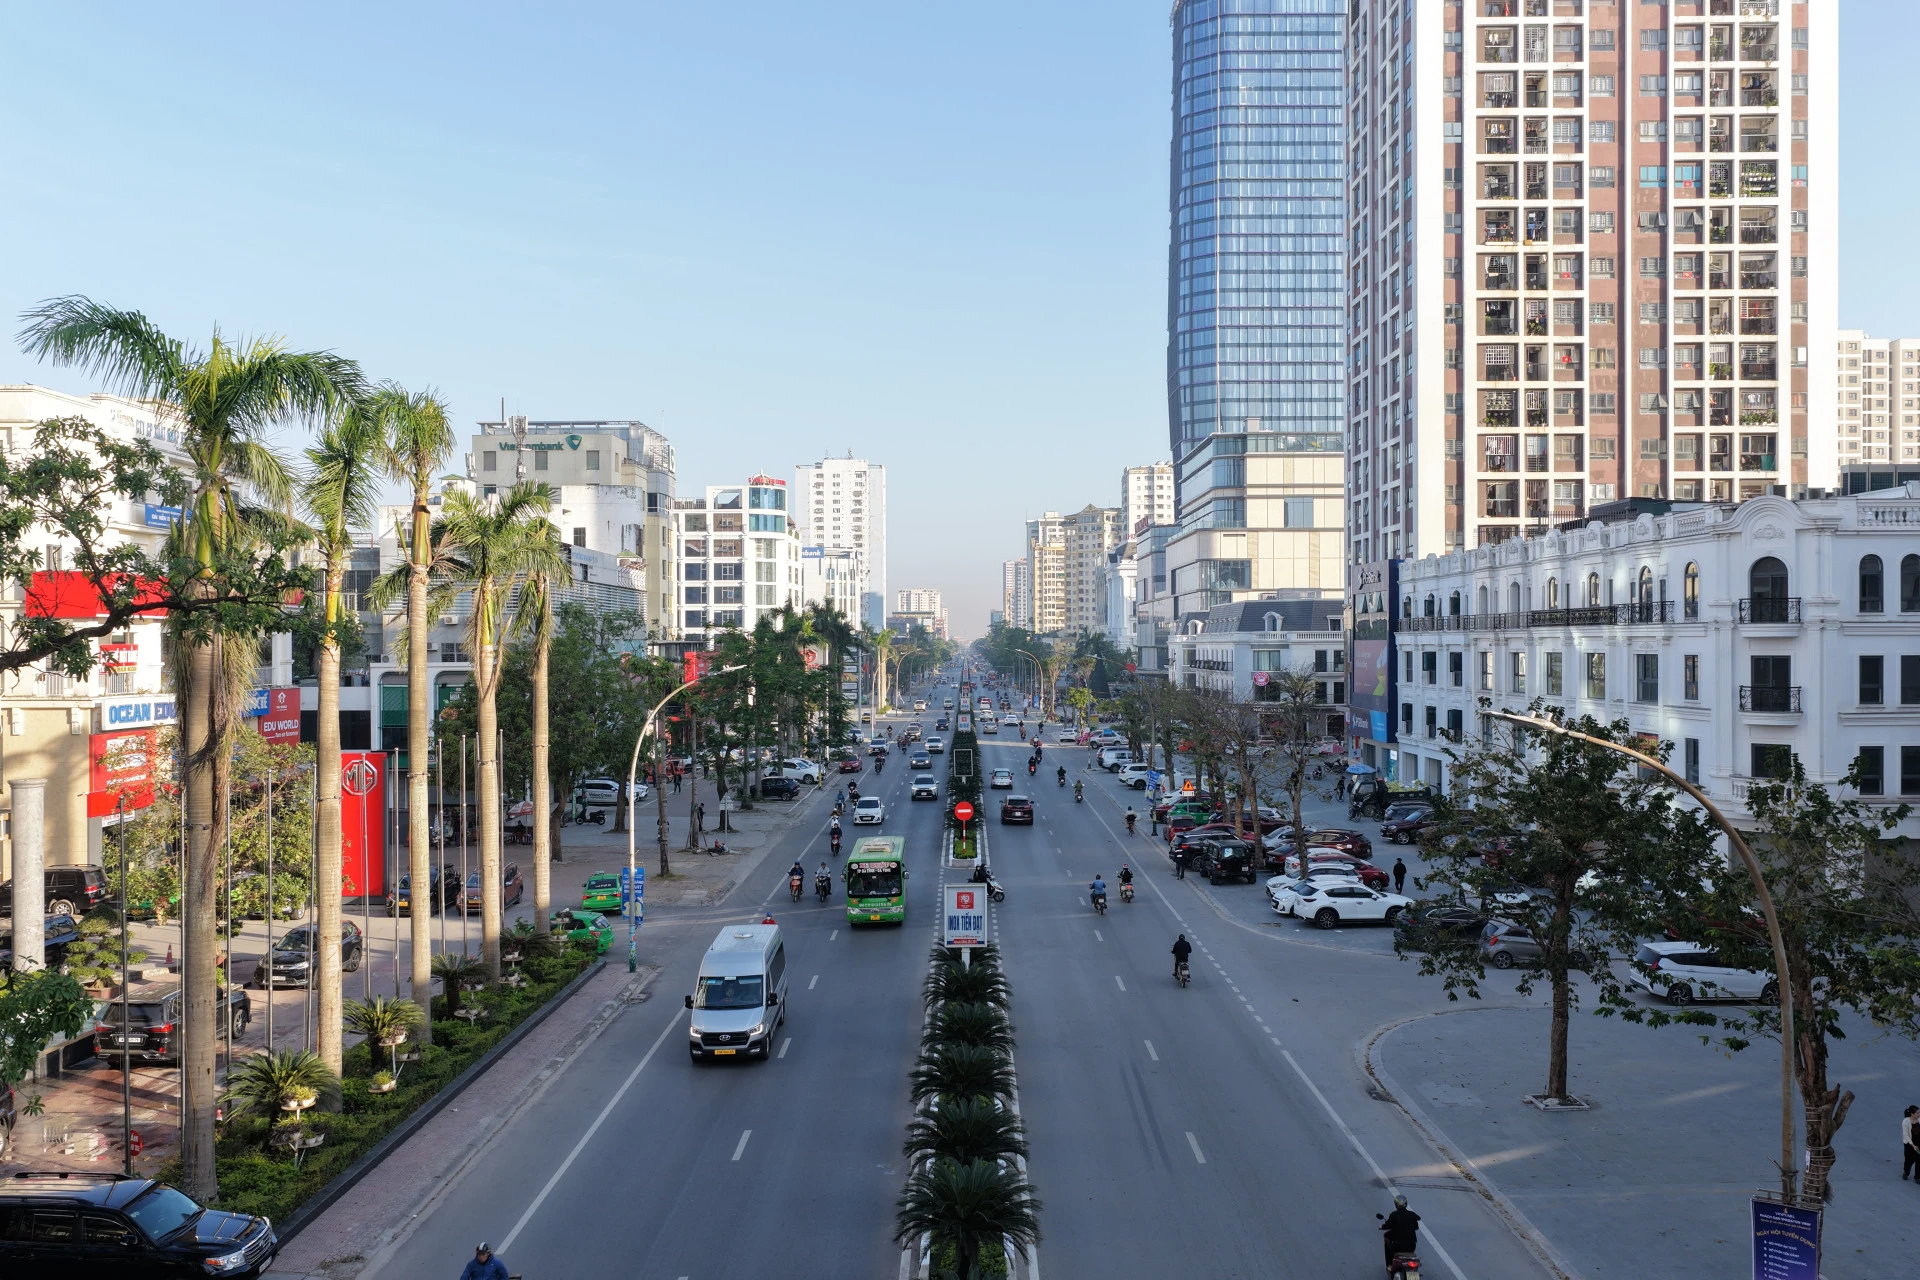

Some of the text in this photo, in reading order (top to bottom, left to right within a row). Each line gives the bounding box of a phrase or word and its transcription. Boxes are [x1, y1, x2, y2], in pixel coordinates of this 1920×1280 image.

[499, 441, 564, 451] Vieombank
[109, 703, 151, 724] OCEAN
[264, 720, 299, 731] EDU WORLD
[346, 763, 373, 792] MG
[948, 912, 982, 934] INOX TIẾN ĐẠT
